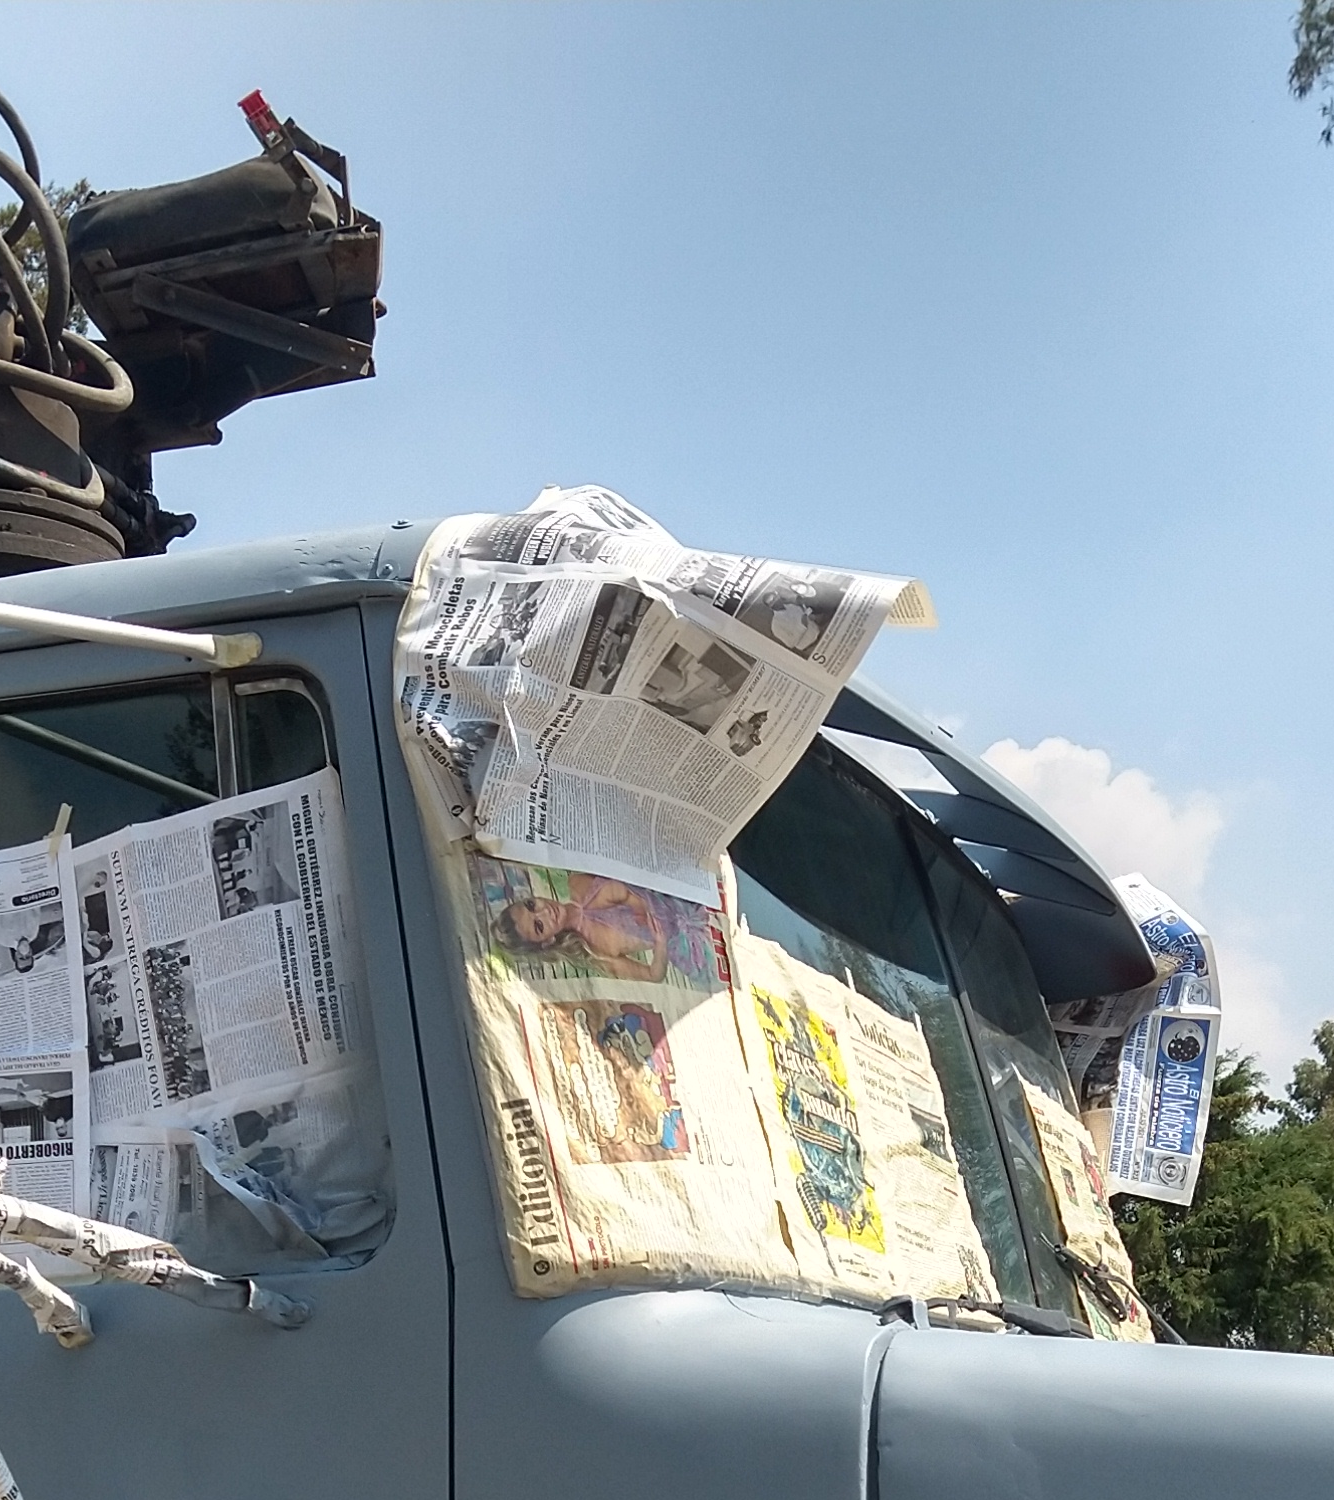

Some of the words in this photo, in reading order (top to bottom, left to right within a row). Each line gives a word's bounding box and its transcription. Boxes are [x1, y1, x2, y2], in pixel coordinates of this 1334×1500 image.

[424, 576, 466, 653] Motocicletas
[453, 598, 477, 635] Robos
[424, 653, 433, 661] a
[436, 631, 459, 689] Combatir
[415, 664, 436, 737] Preventivas
[436, 693, 452, 716] para
[535, 728, 554, 750] Verano
[291, 812, 302, 836] CON
[300, 794, 314, 840] MIGUEL
[294, 838, 304, 852] EL
[296, 853, 313, 913] GOBIERNO
[306, 842, 323, 900] GUTIÉRREZ
[20, 887, 57, 904] Directorio
[273, 909, 288, 968] RECONOCIMIENTOS
[304, 913, 316, 933] DEL
[315, 900, 332, 960] INAUGURA
[1141, 918, 1171, 946] Astro
[1178, 930, 1199, 947] El
[308, 934, 322, 978] ESTADO
[110, 851, 130, 916] SUTEYM
[121, 917, 141, 987] ENTREGA
[133, 988, 155, 1062] CRÉDITOS
[146, 1064, 163, 1109] FOAVI
[314, 979, 324, 995] DE
[324, 961, 337, 990] OBRA
[316, 995, 332, 1041] MÉXICO
[1154, 1061, 1165, 1093] Fuerza
[1165, 1061, 1199, 1096] Astro
[1152, 1094, 1160, 1107] de
[1148, 1109, 1159, 1146] Palabra
[1156, 1097, 1197, 1151] Noticiero
[5, 1142, 74, 1160] RIGOBERTO
[500, 1098, 559, 1247] Editorial
